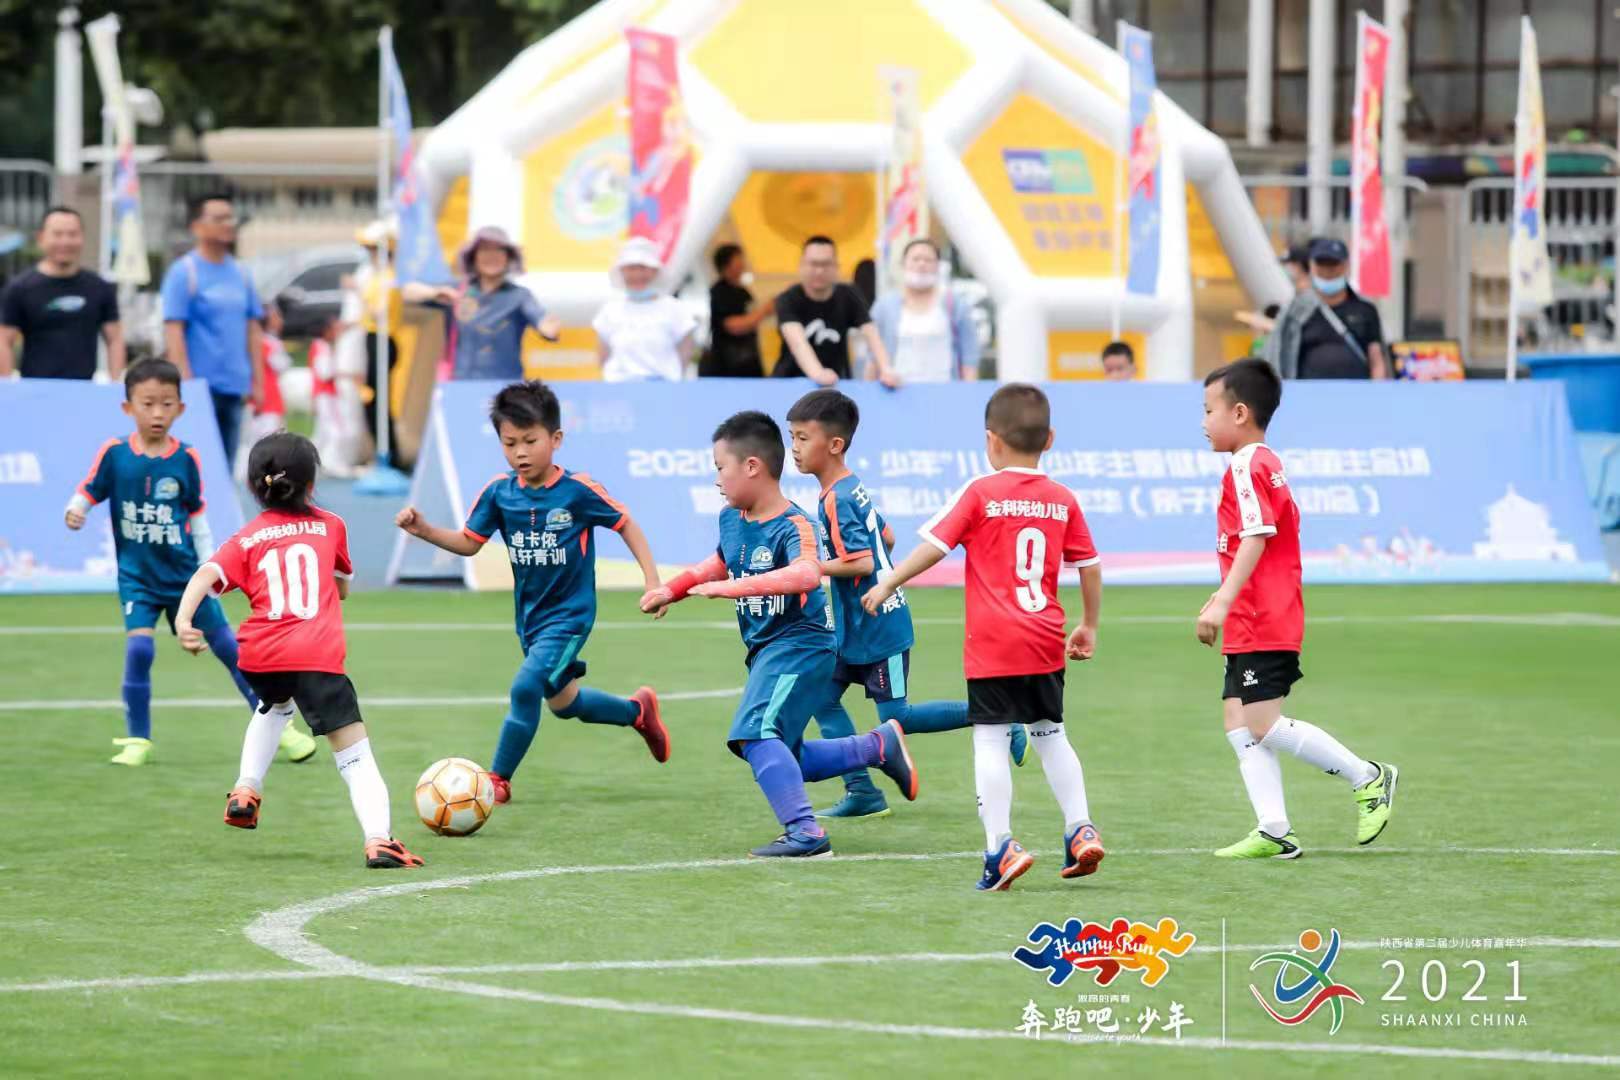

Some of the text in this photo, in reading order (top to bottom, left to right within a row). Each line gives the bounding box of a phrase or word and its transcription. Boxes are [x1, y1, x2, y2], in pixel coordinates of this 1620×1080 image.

[985, 499, 1068, 523] 金利苑幼儿园
[511, 530, 557, 549] 迪卡侬
[257, 542, 319, 620] 10
[1015, 526, 1048, 612] 9
